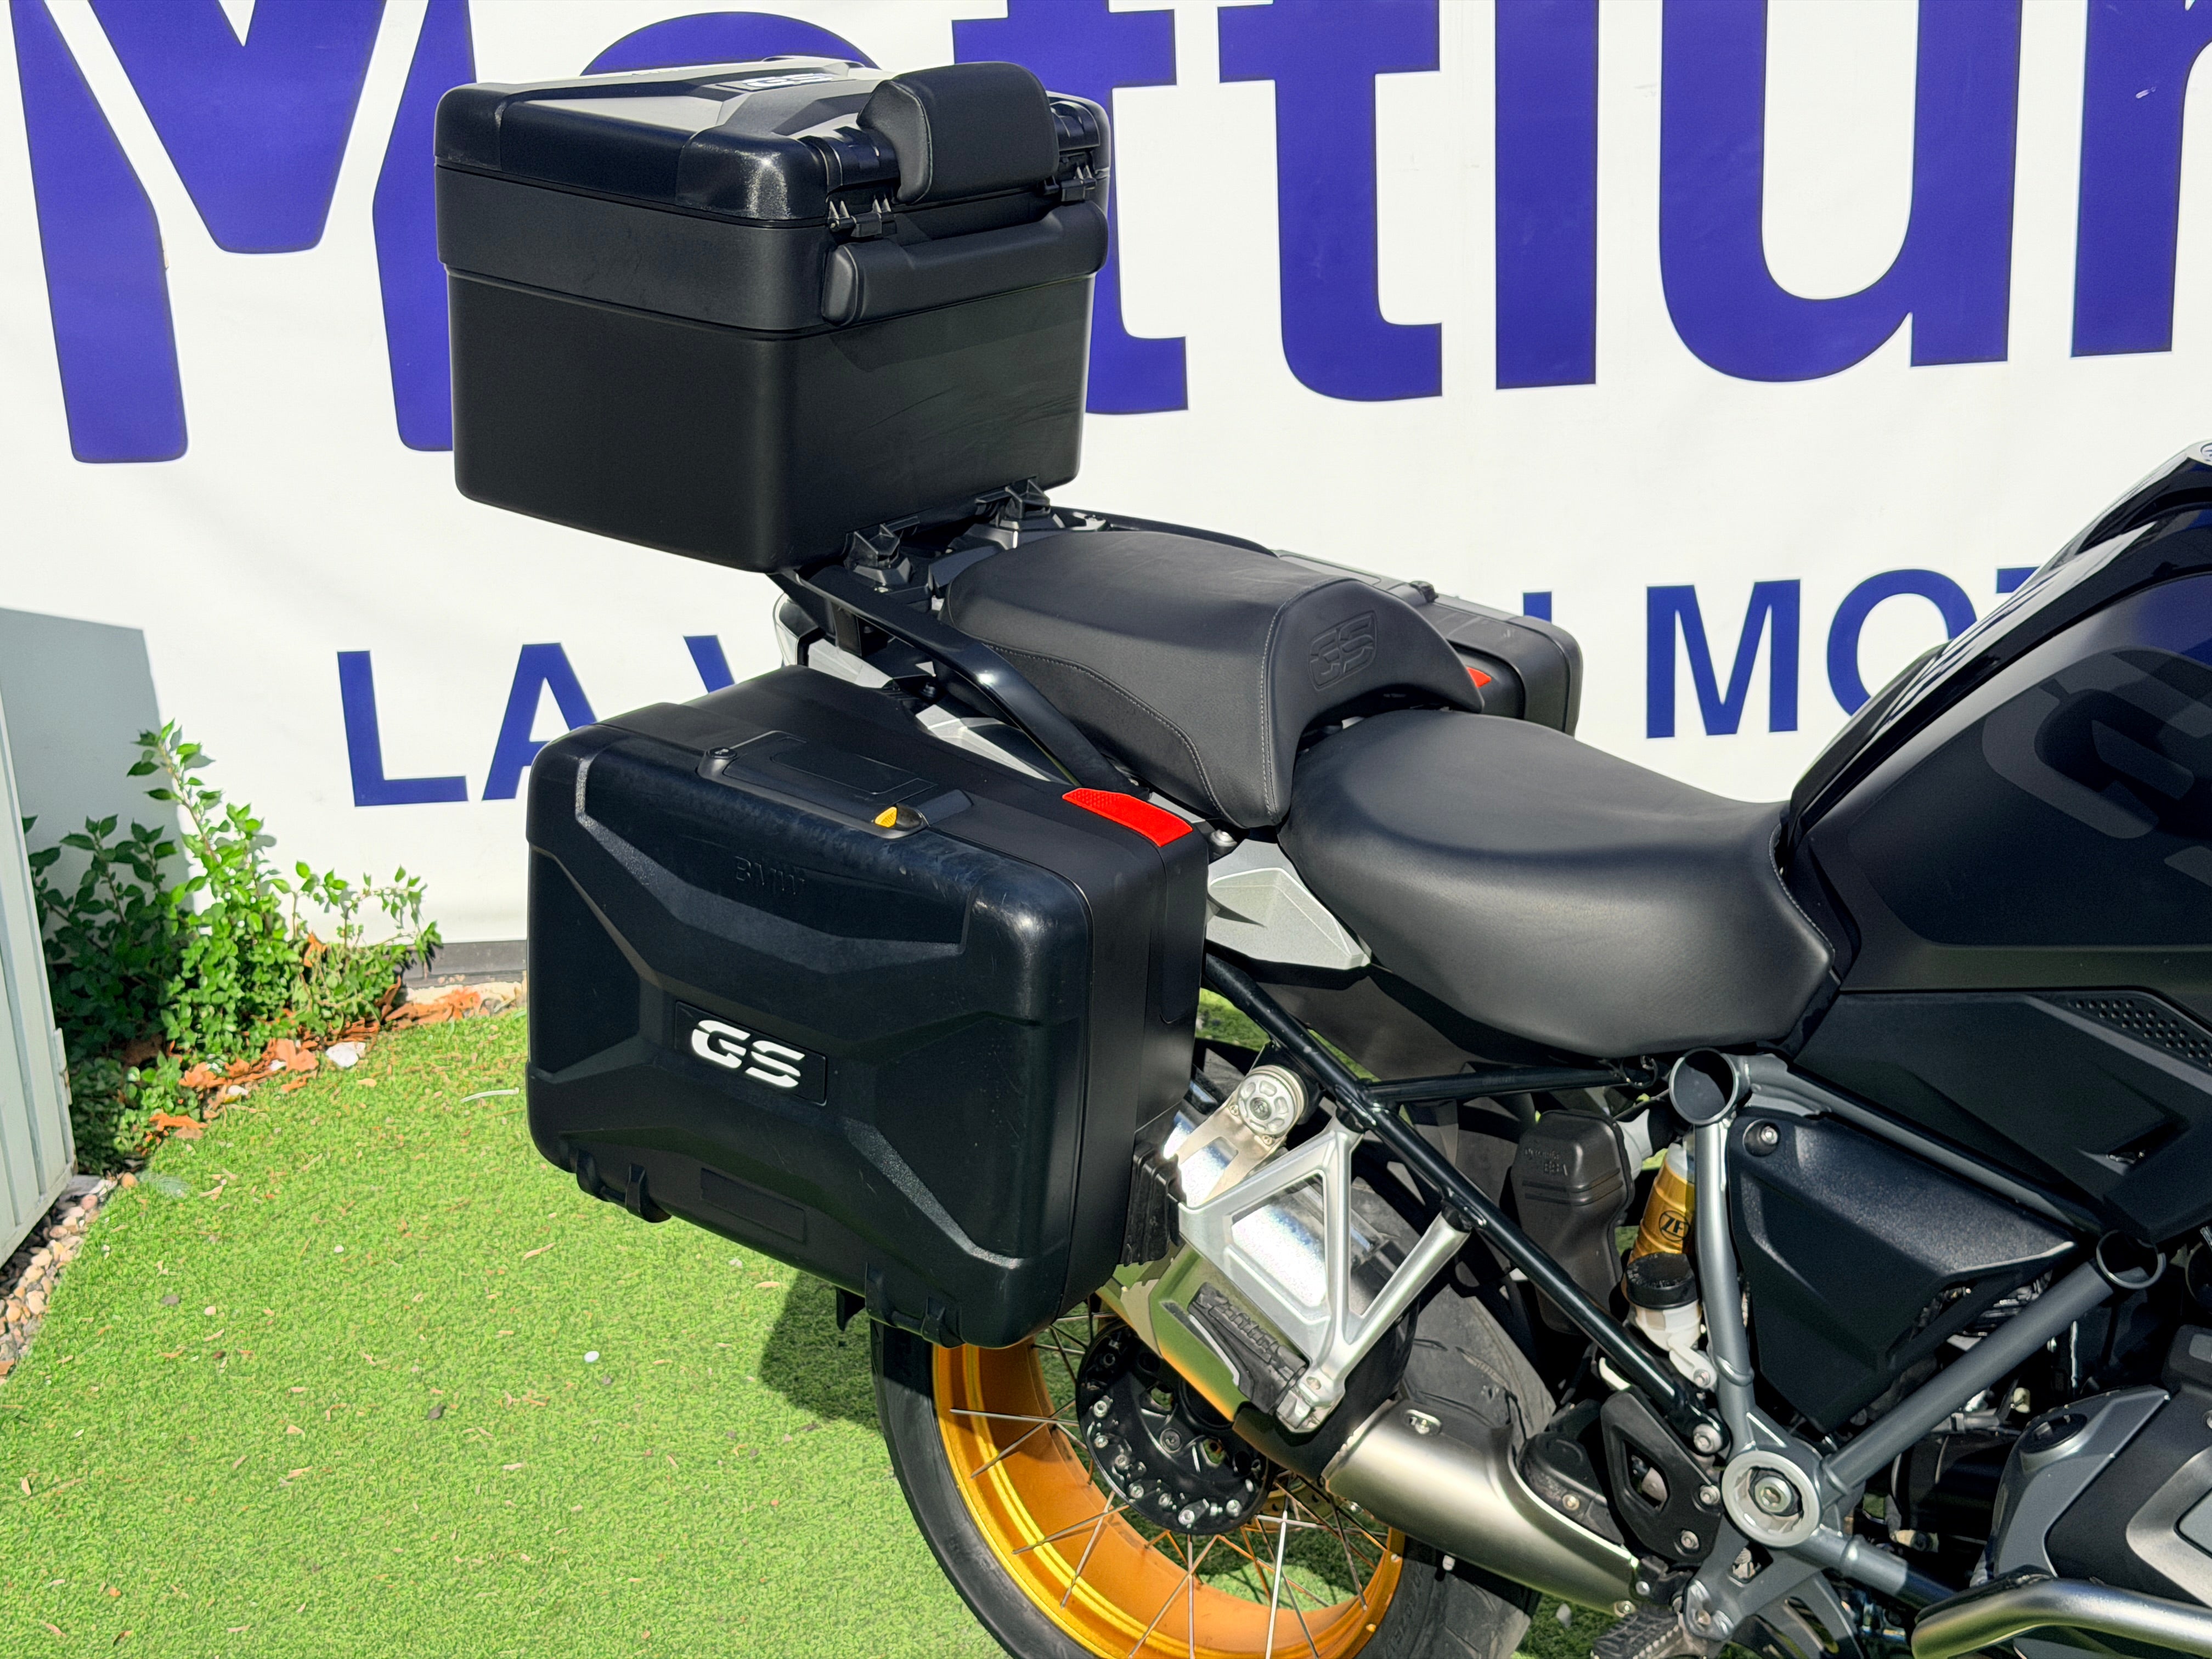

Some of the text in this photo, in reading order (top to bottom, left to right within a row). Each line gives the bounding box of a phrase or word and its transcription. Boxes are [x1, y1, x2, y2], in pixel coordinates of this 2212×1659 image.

[1647, 568, 2038, 738] MO
[691, 1019, 805, 1088] GS
[1661, 1213, 1688, 1235] ZF
